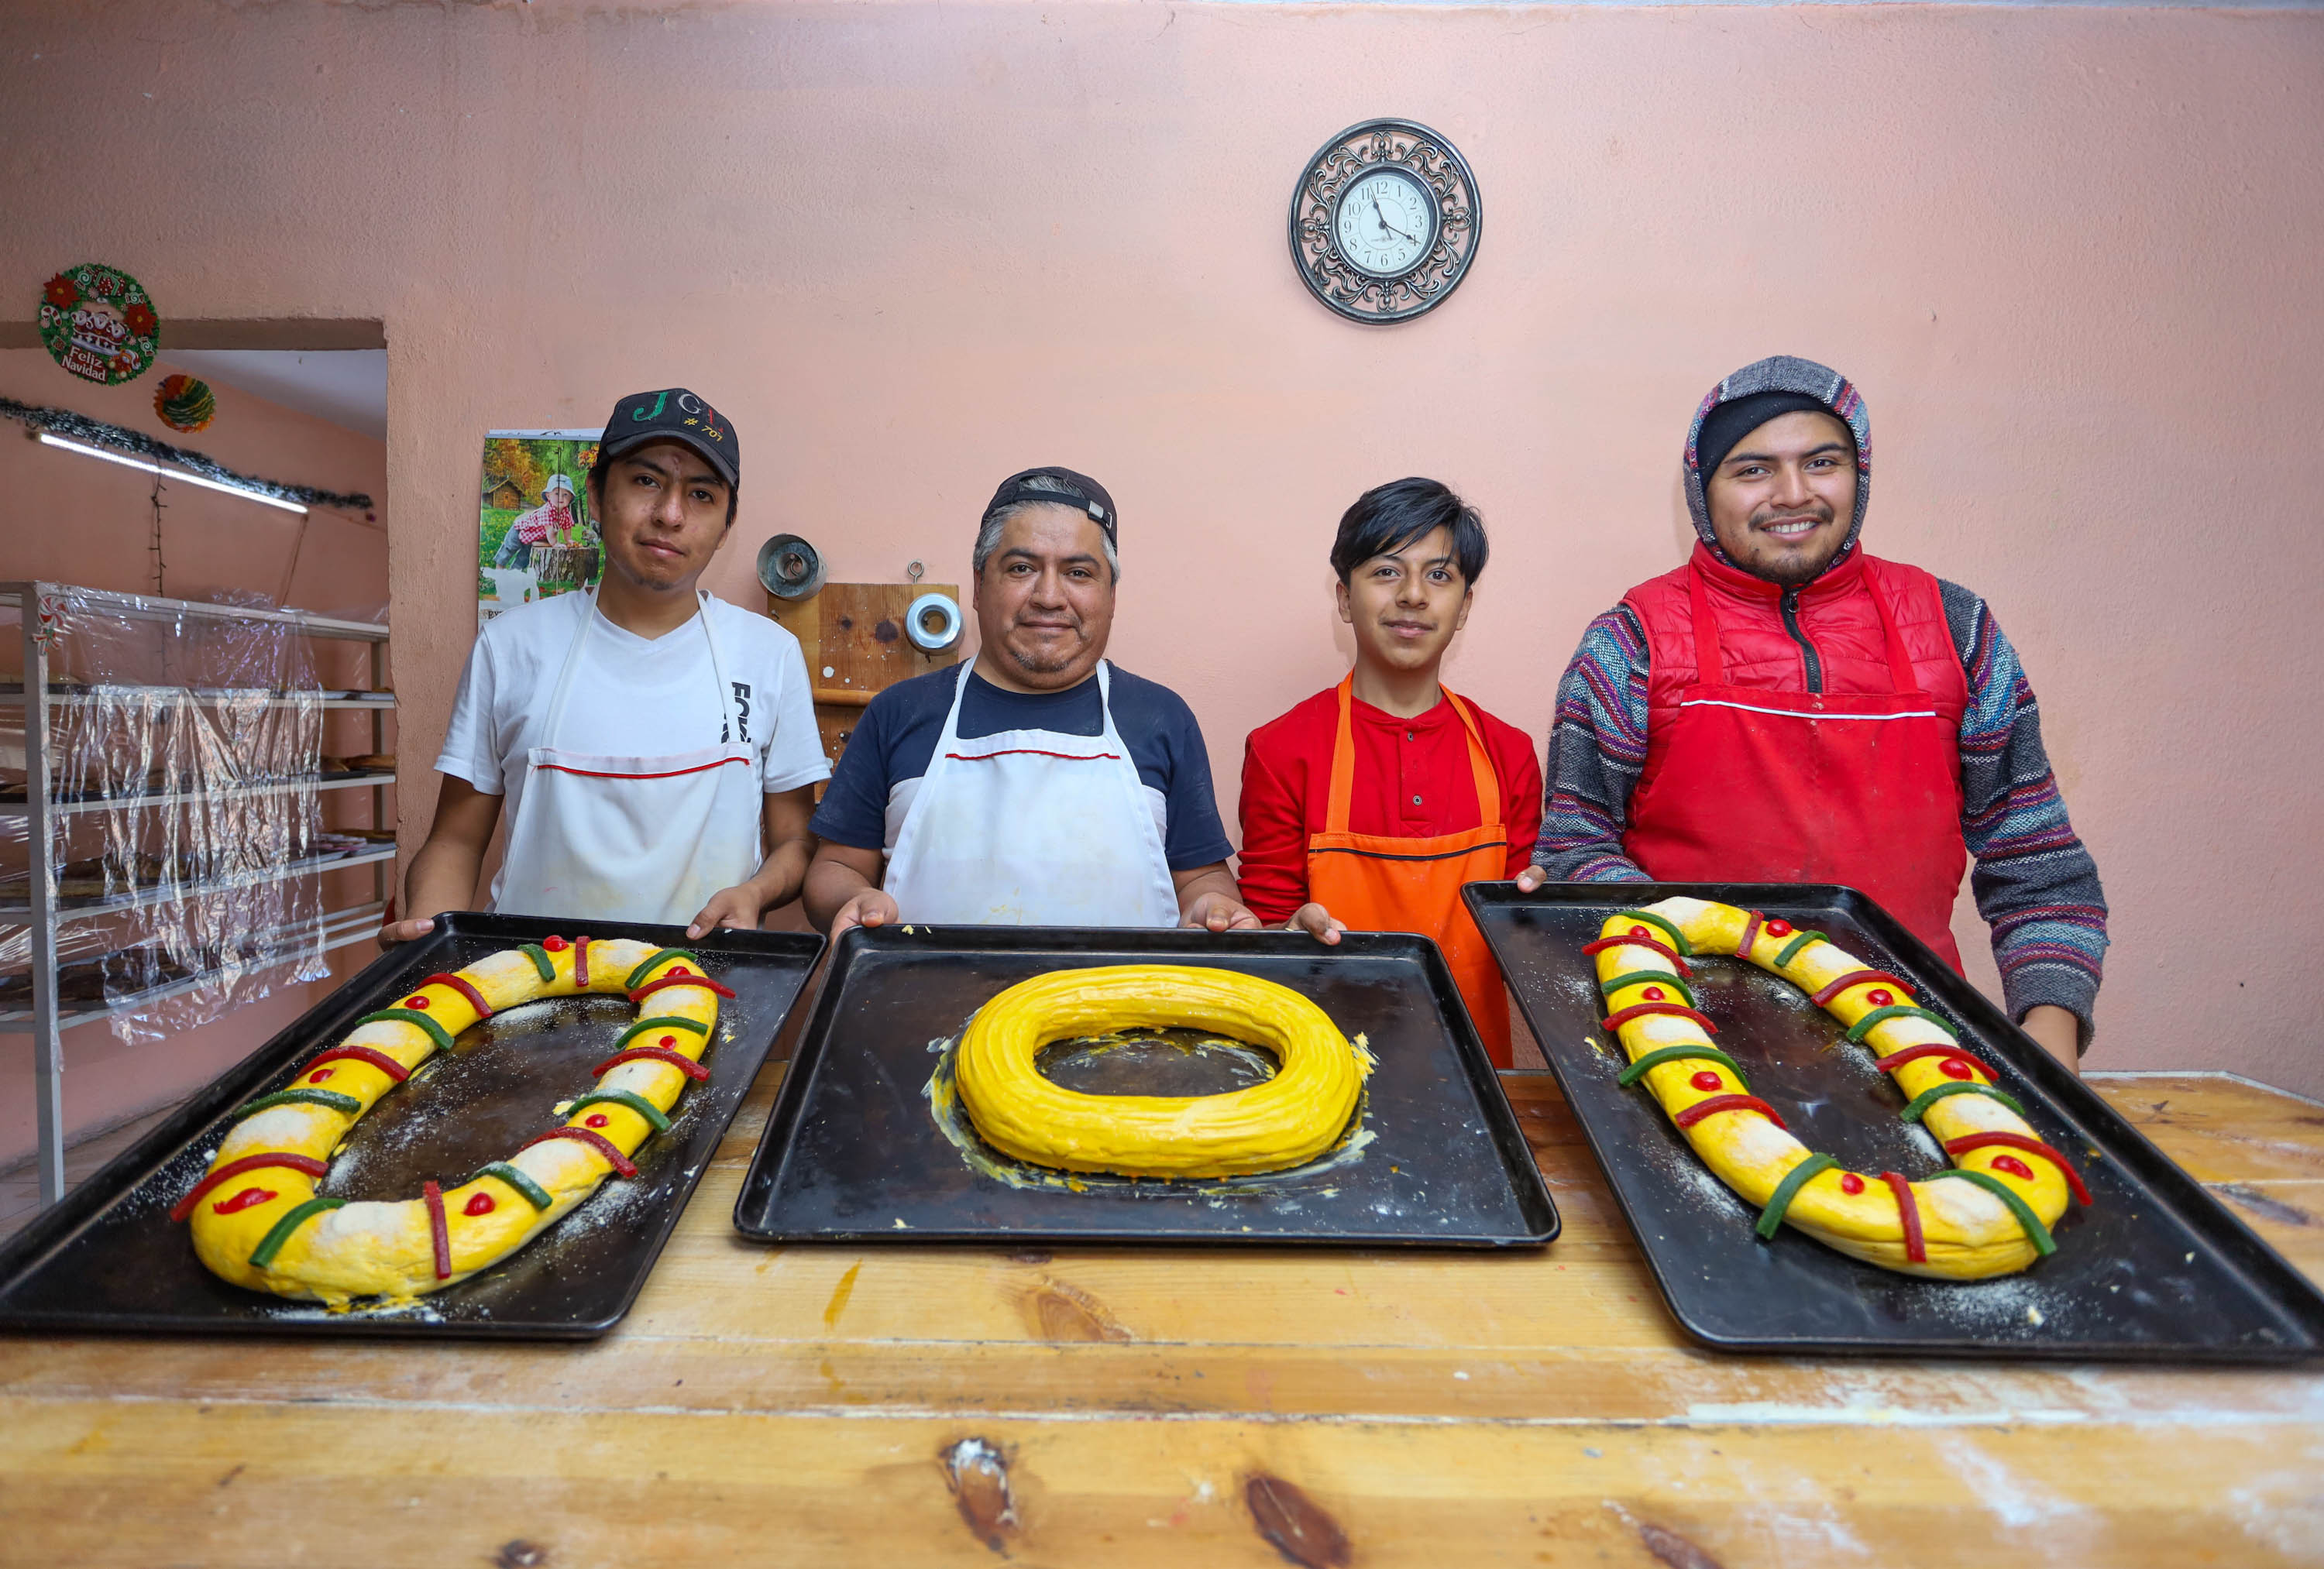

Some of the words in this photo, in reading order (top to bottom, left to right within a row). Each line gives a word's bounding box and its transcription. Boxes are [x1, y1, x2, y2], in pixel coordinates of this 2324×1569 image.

[1361, 187, 1370, 200] 11
[1376, 181, 1388, 194] 12
[1397, 185, 1401, 197] 1
[1348, 202, 1361, 216] 10
[1409, 197, 1417, 210] 2
[1344, 220, 1352, 233] 9
[1415, 215, 1423, 228] 3
[1349, 237, 1357, 251] 8
[1408, 234, 1418, 246] 4
[1364, 250, 1371, 263] 7
[1380, 253, 1388, 267] 6
[1397, 248, 1406, 261] 5
[70, 345, 103, 367] Feliz
[62, 355, 106, 382] Navidad
